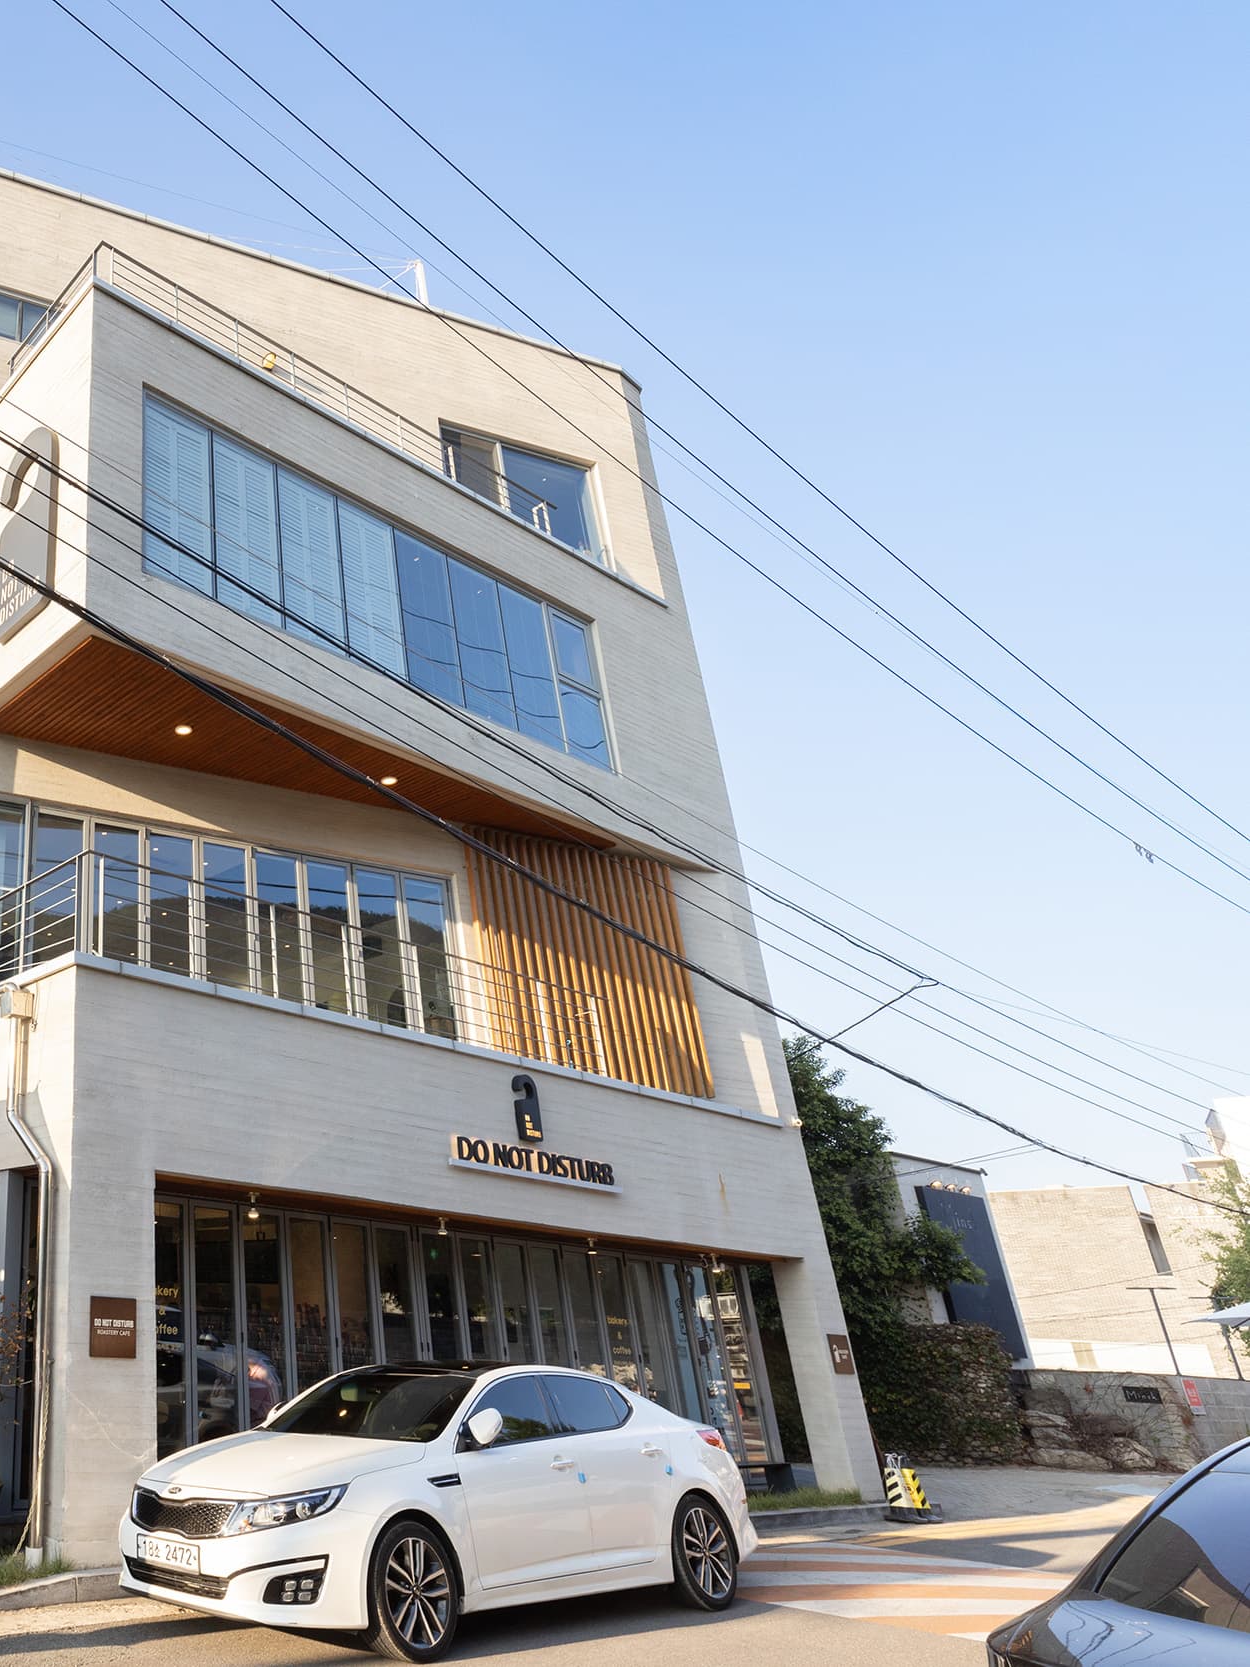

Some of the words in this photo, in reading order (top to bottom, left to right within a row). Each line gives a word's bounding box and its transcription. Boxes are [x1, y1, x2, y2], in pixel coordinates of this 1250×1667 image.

[457, 1136, 490, 1164] DO
[493, 1143, 534, 1172] NOT
[165, 1544, 192, 1565] 2472
